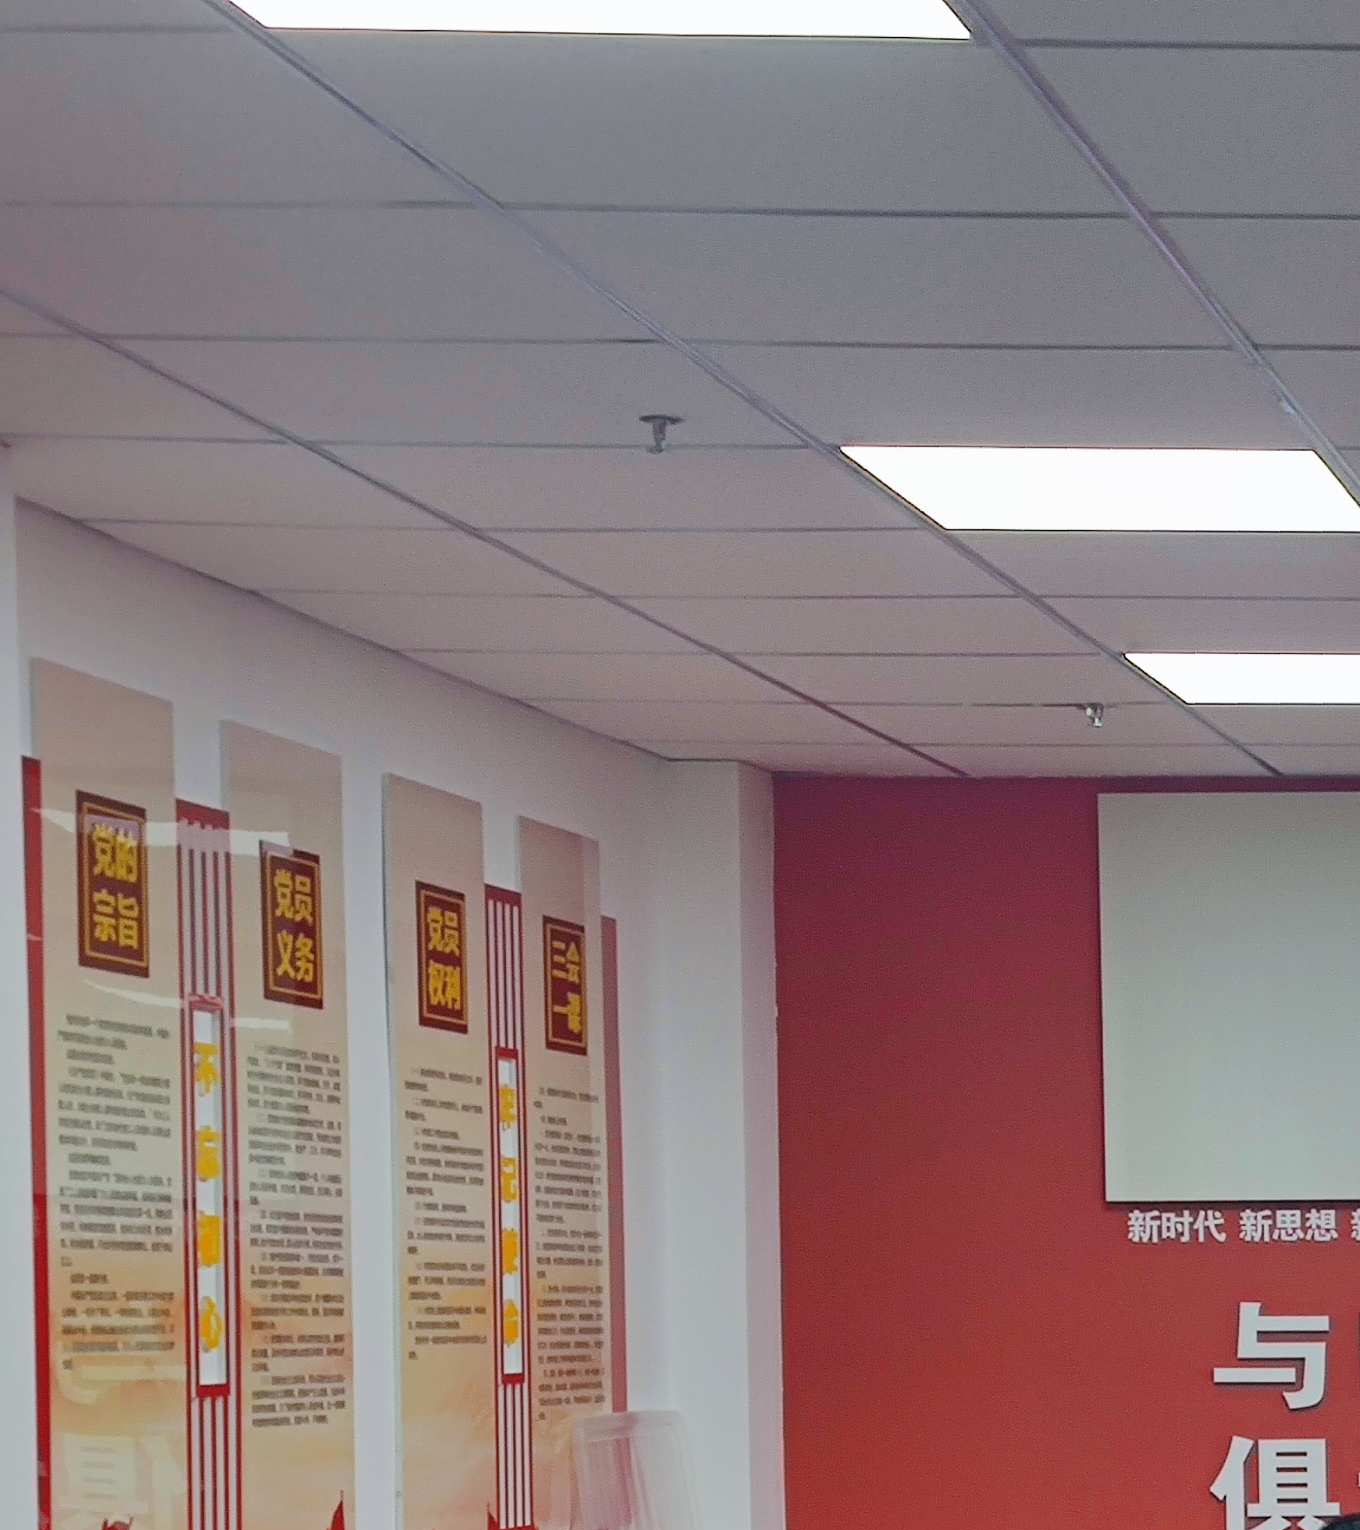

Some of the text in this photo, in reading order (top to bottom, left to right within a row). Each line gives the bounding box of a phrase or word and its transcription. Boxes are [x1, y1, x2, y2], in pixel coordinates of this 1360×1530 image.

[92, 823, 138, 883] 党的
[92, 889, 139, 949] 宗旨
[273, 868, 313, 926] 党员
[276, 930, 314, 983] 义务
[427, 906, 460, 957] 党员
[428, 959, 462, 1010] 权利
[551, 940, 580, 984] 三会
[1127, 1208, 1226, 1243] 新时代
[1238, 1208, 1338, 1243] 新思想
